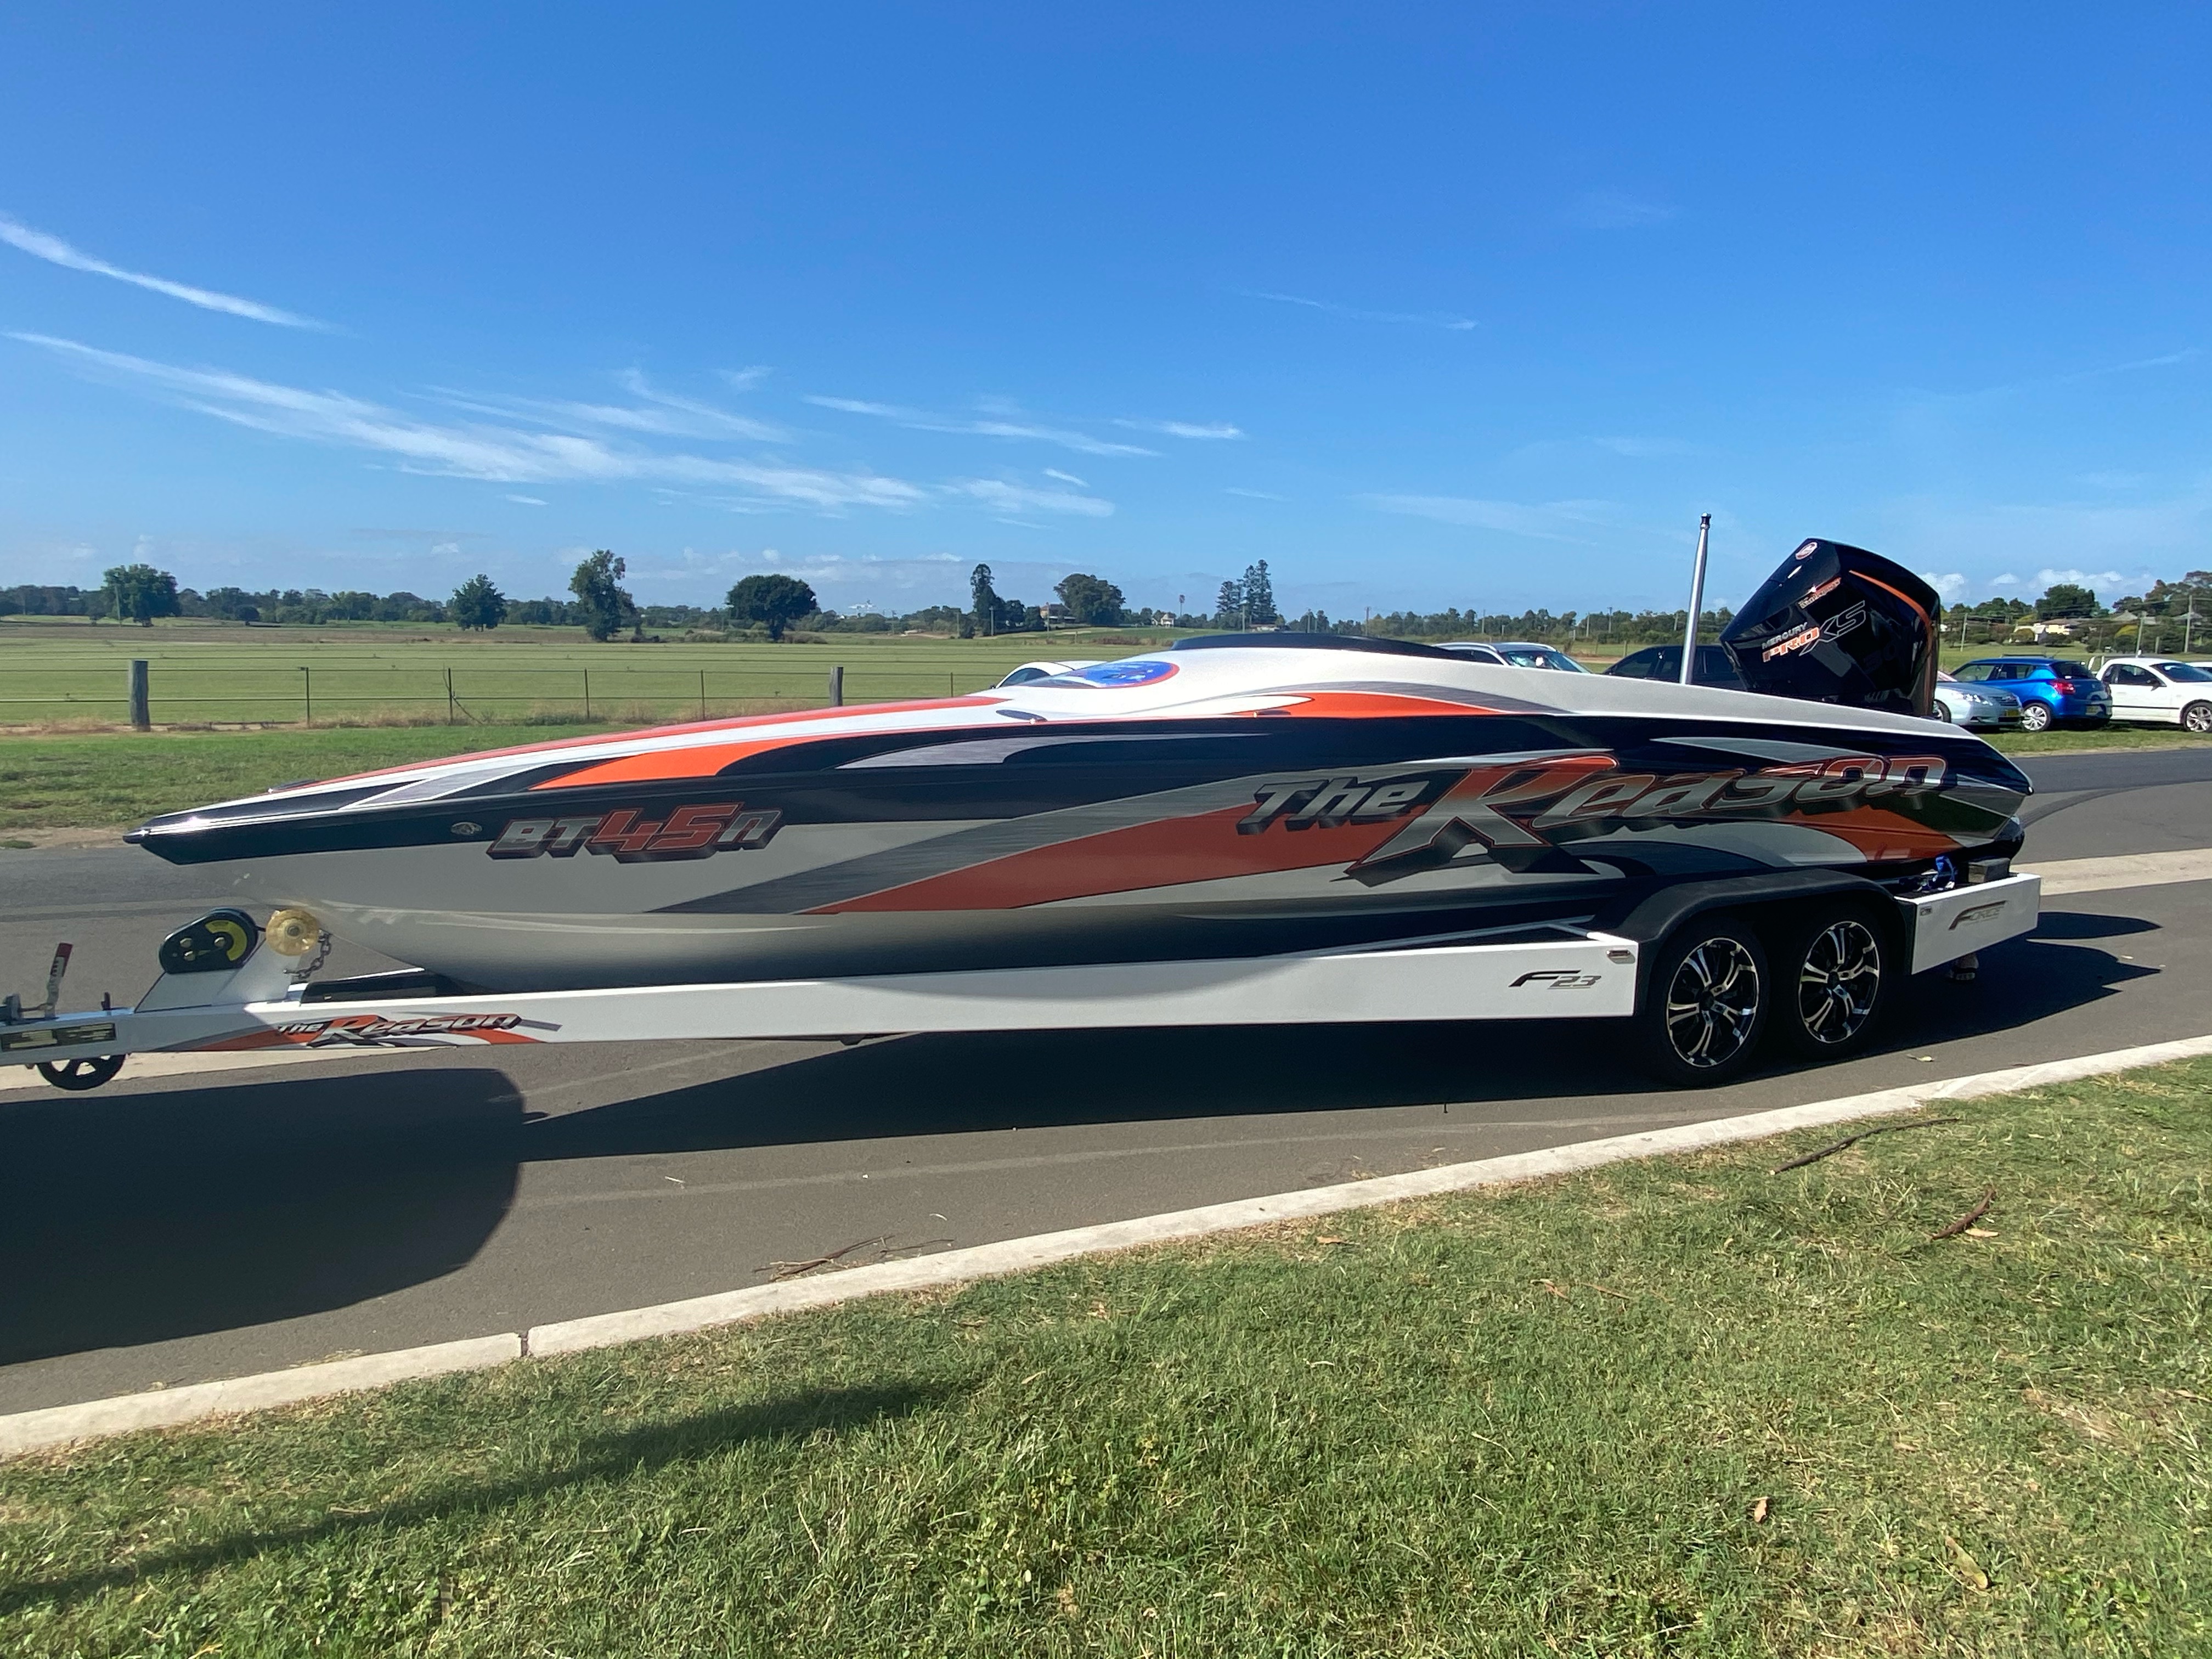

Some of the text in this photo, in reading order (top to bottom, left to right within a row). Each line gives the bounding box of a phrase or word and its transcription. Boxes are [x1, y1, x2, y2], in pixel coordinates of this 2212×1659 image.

[1762, 600, 1866, 663] PRO XS
[1762, 622, 1808, 650] MERCURY
[1237, 753, 1948, 884] The Reason
[1508, 969, 1601, 990] F23
[276, 1013, 523, 1048] The Reason
